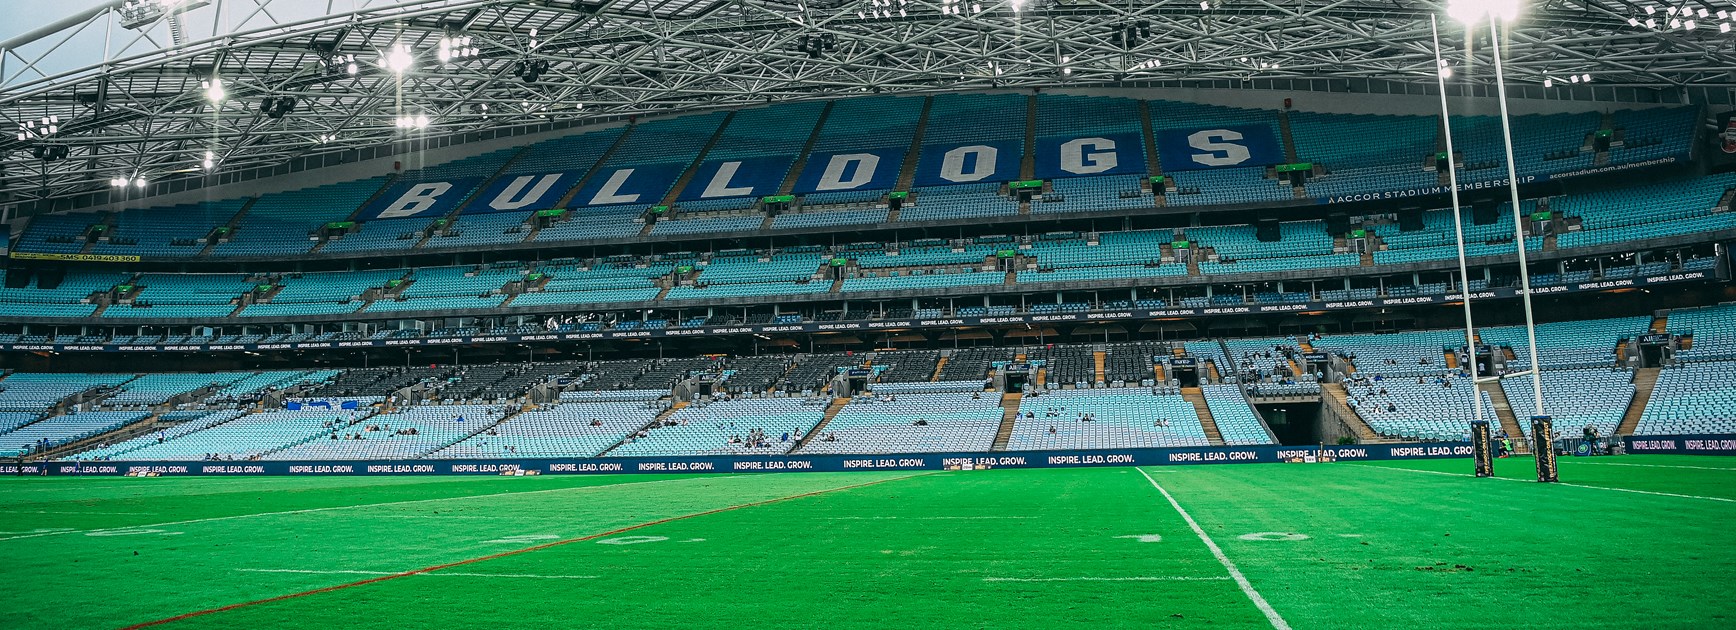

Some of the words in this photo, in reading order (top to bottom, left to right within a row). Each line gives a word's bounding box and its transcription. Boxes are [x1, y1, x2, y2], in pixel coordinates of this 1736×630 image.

[1550, 156, 1675, 179] accorstadium.com.au/membership
[377, 129, 1251, 218] BULLDOGS
[1338, 192, 1380, 203] ACCOR
[1384, 186, 1440, 198] STADIUM
[1632, 441, 1647, 449] INSPIRE.
[1648, 441, 1661, 449] LEAD.
[1661, 441, 1676, 450] GROW.
[1685, 440, 1705, 450] INSPIRE.
[1706, 440, 1720, 450] LEAD.
[1169, 453, 1202, 461] INSPIRE.
[1203, 452, 1228, 460] LEAD.
[1229, 451, 1258, 459] GROW.
[1277, 450, 1310, 458] INSPIRE
[1338, 449, 1368, 457] GROW.
[1390, 448, 1426, 456] INSPIRE.
[1428, 446, 1452, 455] LEAD.
[1454, 446, 1474, 454] GRO
[975, 457, 998, 465] LEAD.
[1000, 457, 1027, 465] GROW.
[1048, 456, 1080, 464] INSPIRE.
[1082, 455, 1106, 463] LEAD.
[1107, 454, 1135, 462] GROW.
